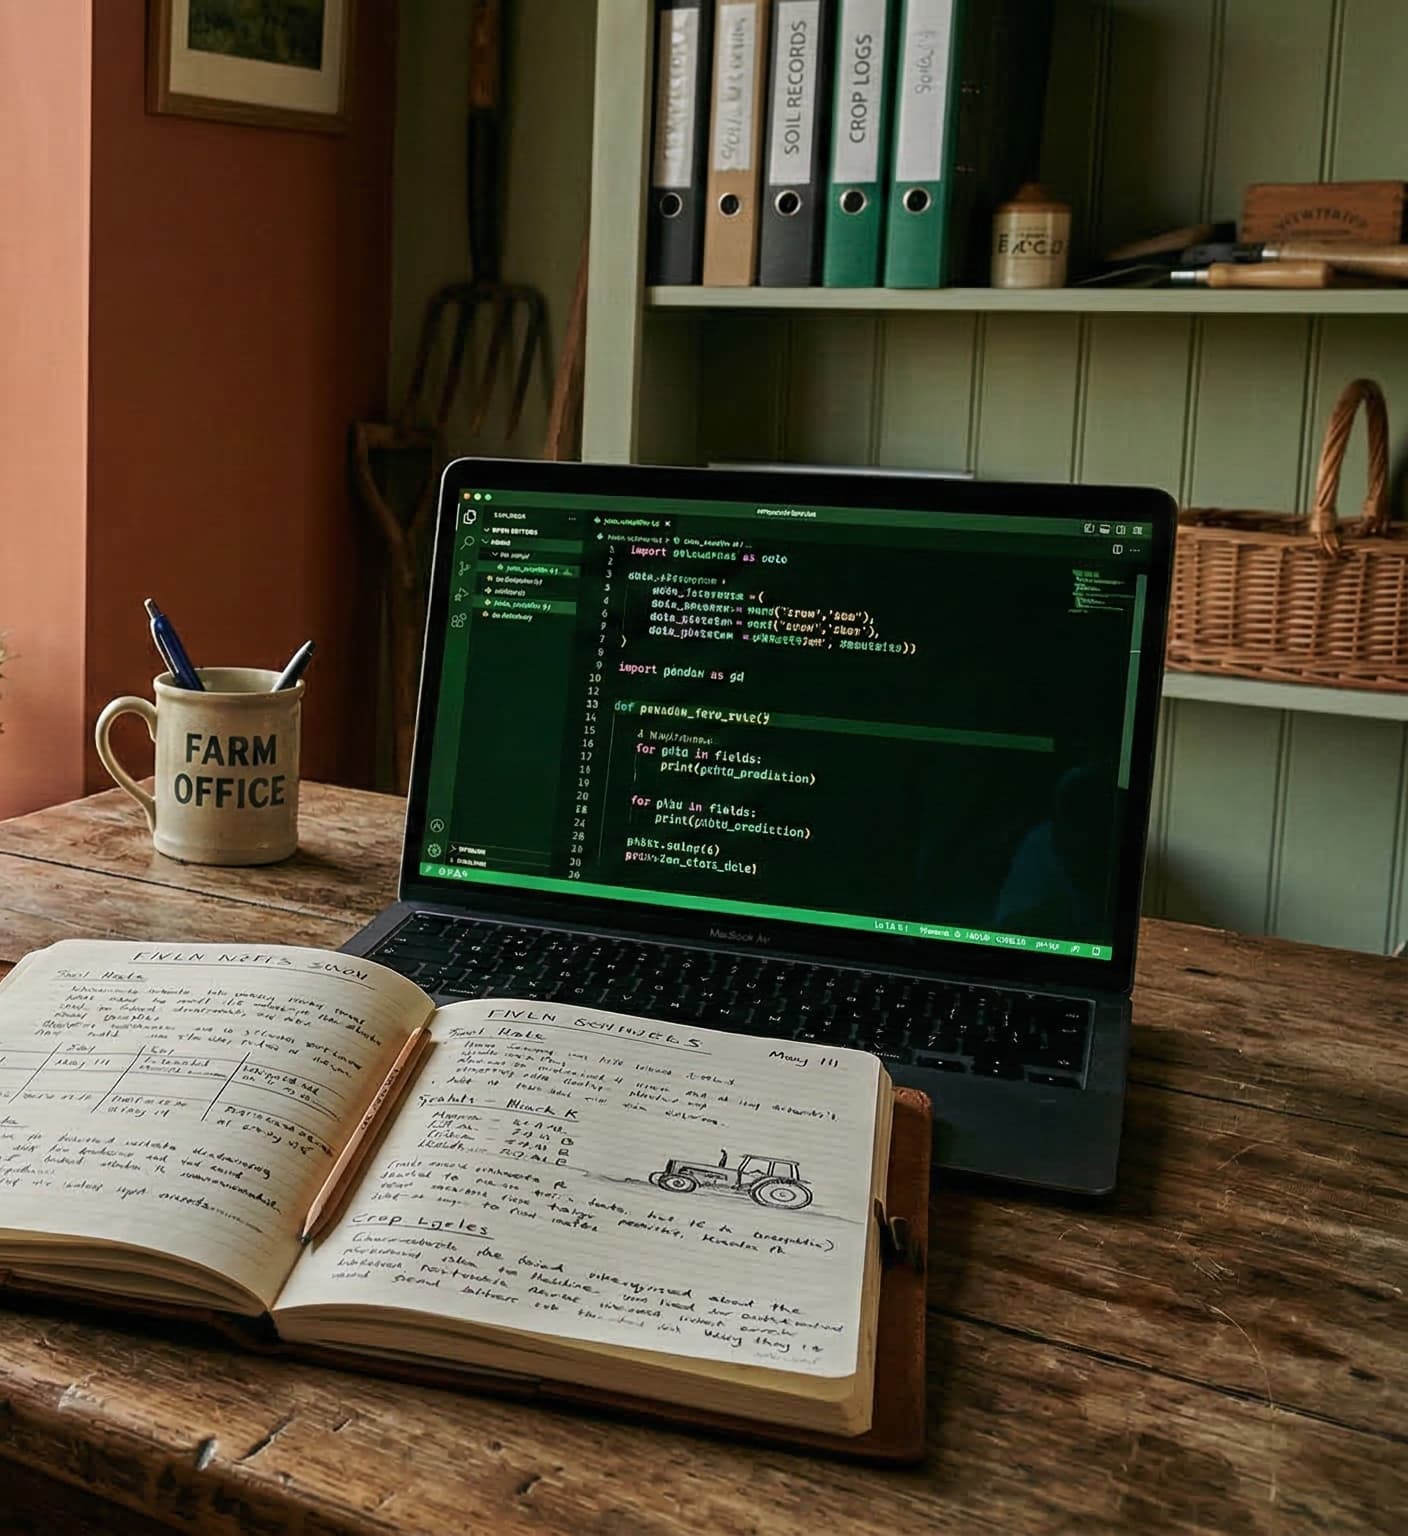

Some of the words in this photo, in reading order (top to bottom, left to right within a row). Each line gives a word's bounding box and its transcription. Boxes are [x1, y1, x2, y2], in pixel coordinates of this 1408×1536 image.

[787, 20, 807, 108] RECORDS
[853, 33, 872, 86] LOGS
[849, 91, 869, 144] CROP
[784, 113, 801, 156] SOIL
[589, 673, 601, 682] 10
[587, 687, 600, 696] 12
[585, 713, 596, 722] 14
[584, 726, 595, 735] 15
[185, 732, 277, 766] FARM
[580, 752, 592, 761] 17
[582, 739, 594, 748] 16
[635, 743, 656, 754] for
[695, 748, 708, 759] in
[715, 751, 762, 764] fields:
[174, 773, 286, 809] OFFICE
[578, 778, 590, 787] 19
[576, 791, 589, 801] 20
[631, 795, 651, 806] for
[689, 802, 702, 813] in
